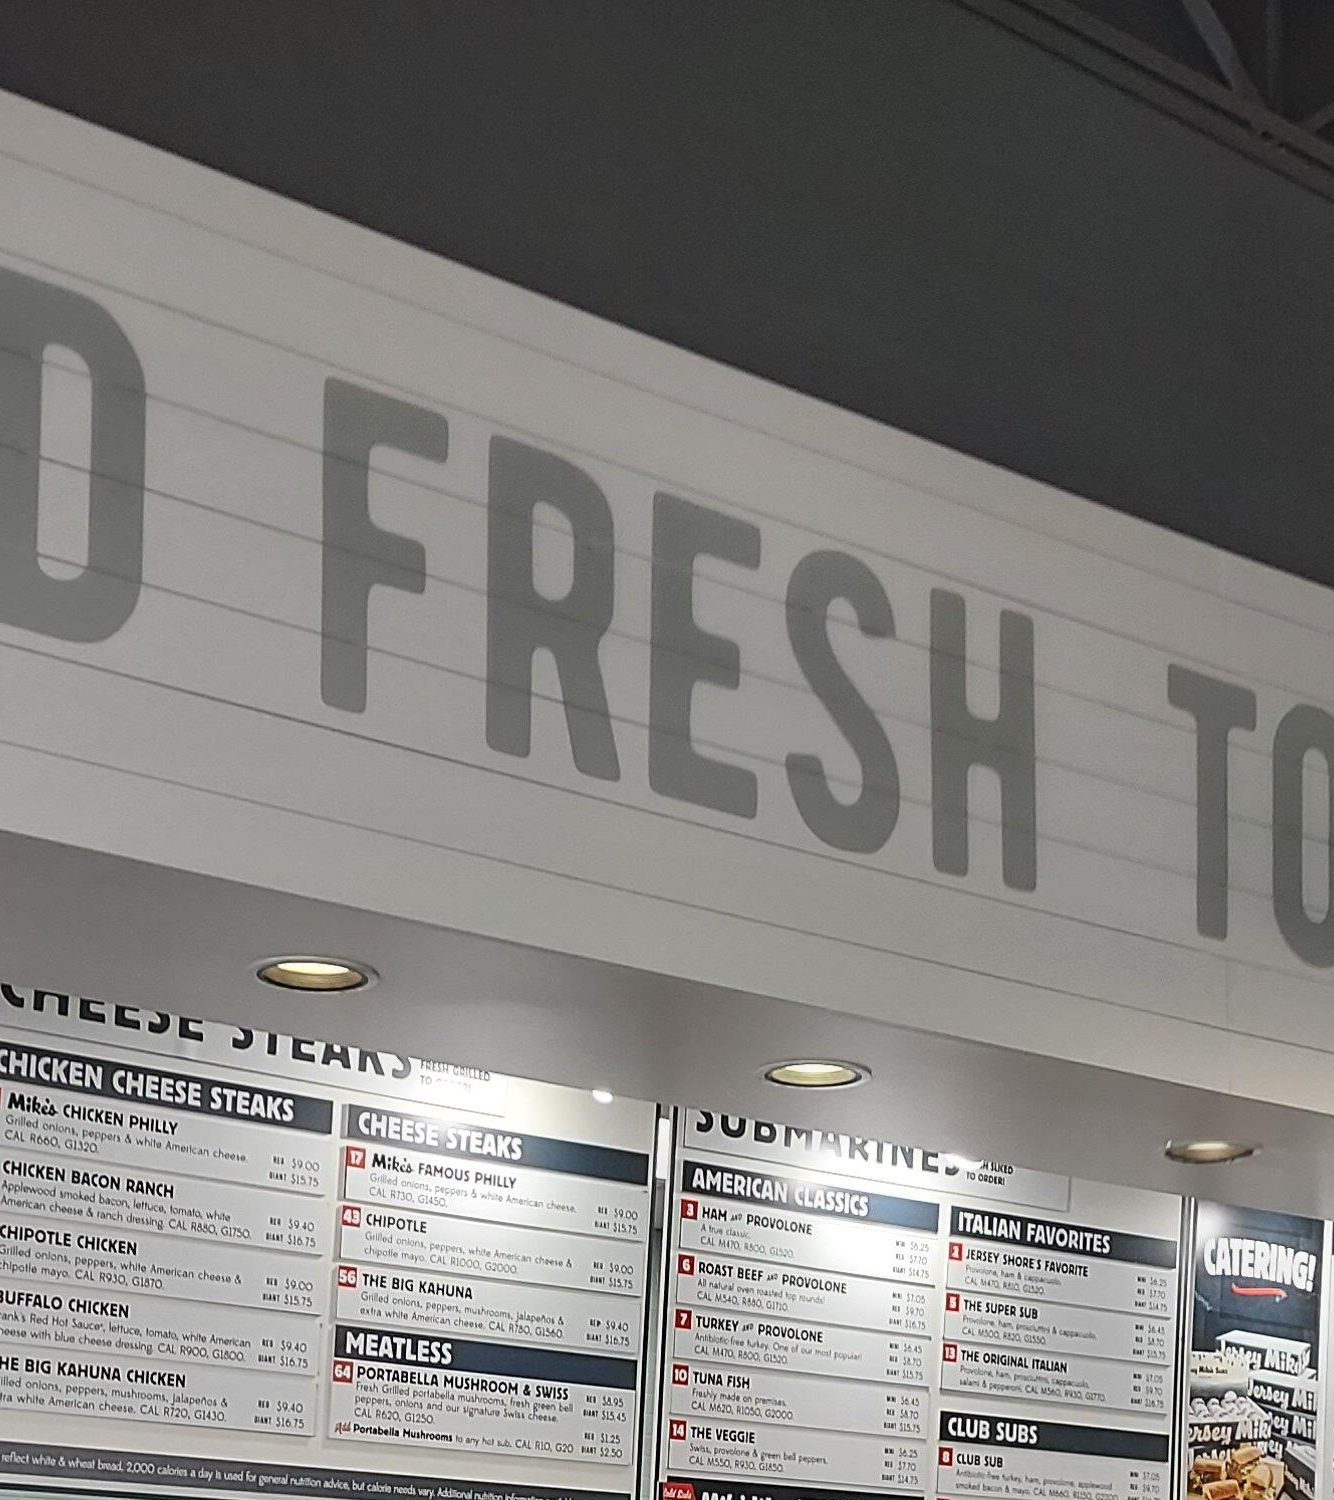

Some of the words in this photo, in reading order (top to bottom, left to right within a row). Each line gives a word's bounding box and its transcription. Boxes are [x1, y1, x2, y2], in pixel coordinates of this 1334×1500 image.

[320, 377, 1039, 893] FRESH
[112, 1071, 202, 1107] CHEESE
[210, 1089, 295, 1122] STEAKS
[8, 1092, 59, 1116] Mike's
[62, 1104, 125, 1127] CHICKEN
[130, 1116, 178, 1135] PHILLY
[359, 1111, 440, 1147] CHEESE
[446, 1127, 523, 1160] STEAKS
[2, 1159, 67, 1183] CHICKEN
[70, 1170, 123, 1190] BACON
[126, 1179, 175, 1198] RANCH
[372, 1151, 415, 1172] Mike's
[418, 1163, 471, 1187] FAMOUS
[474, 1173, 517, 1190] PHILLY
[693, 1168, 788, 1203] AMERICAN
[794, 1187, 868, 1217] CLASSICS
[366, 1213, 427, 1234] CHIPOTLE
[702, 1206, 727, 1222] HAM
[747, 1214, 813, 1235] PROVOLONE
[958, 1211, 1021, 1239] ITALIAN
[1026, 1226, 1111, 1254] FAVORITES
[0, 1224, 73, 1249] CHIPOTLE
[77, 1235, 138, 1255] CHICKEN
[699, 1262, 734, 1279] ROAST
[737, 1266, 764, 1281] BEEF
[782, 1273, 847, 1294] PROVOLONE
[966, 1249, 999, 1265] JERSEY
[1044, 1260, 1088, 1278] FAVORITE
[1203, 1238, 1317, 1293] CATERING!
[362, 1274, 388, 1290] THE
[391, 1276, 417, 1293] BIG
[420, 1280, 473, 1300] KAHUNA
[68, 1299, 130, 1318] CHICKEN
[696, 1315, 739, 1333] TURKEY
[758, 1323, 824, 1343] PROVOLONE
[345, 1331, 452, 1364] MEATLESS
[961, 1350, 980, 1363] THE
[983, 1353, 1028, 1370] ORIGINAL
[1031, 1359, 1067, 1373] ITALIAN
[21, 1357, 52, 1374] BIG
[57, 1361, 122, 1384] KAHUNA
[126, 1369, 186, 1388] CHICKEN
[356, 1366, 440, 1387] PORTABELLA
[443, 1374, 519, 1395] MUSHROOM
[523, 1382, 533, 1396] &
[537, 1383, 569, 1401] SWISS
[947, 1417, 990, 1440] CLUB
[995, 1423, 1038, 1445] SUBS
